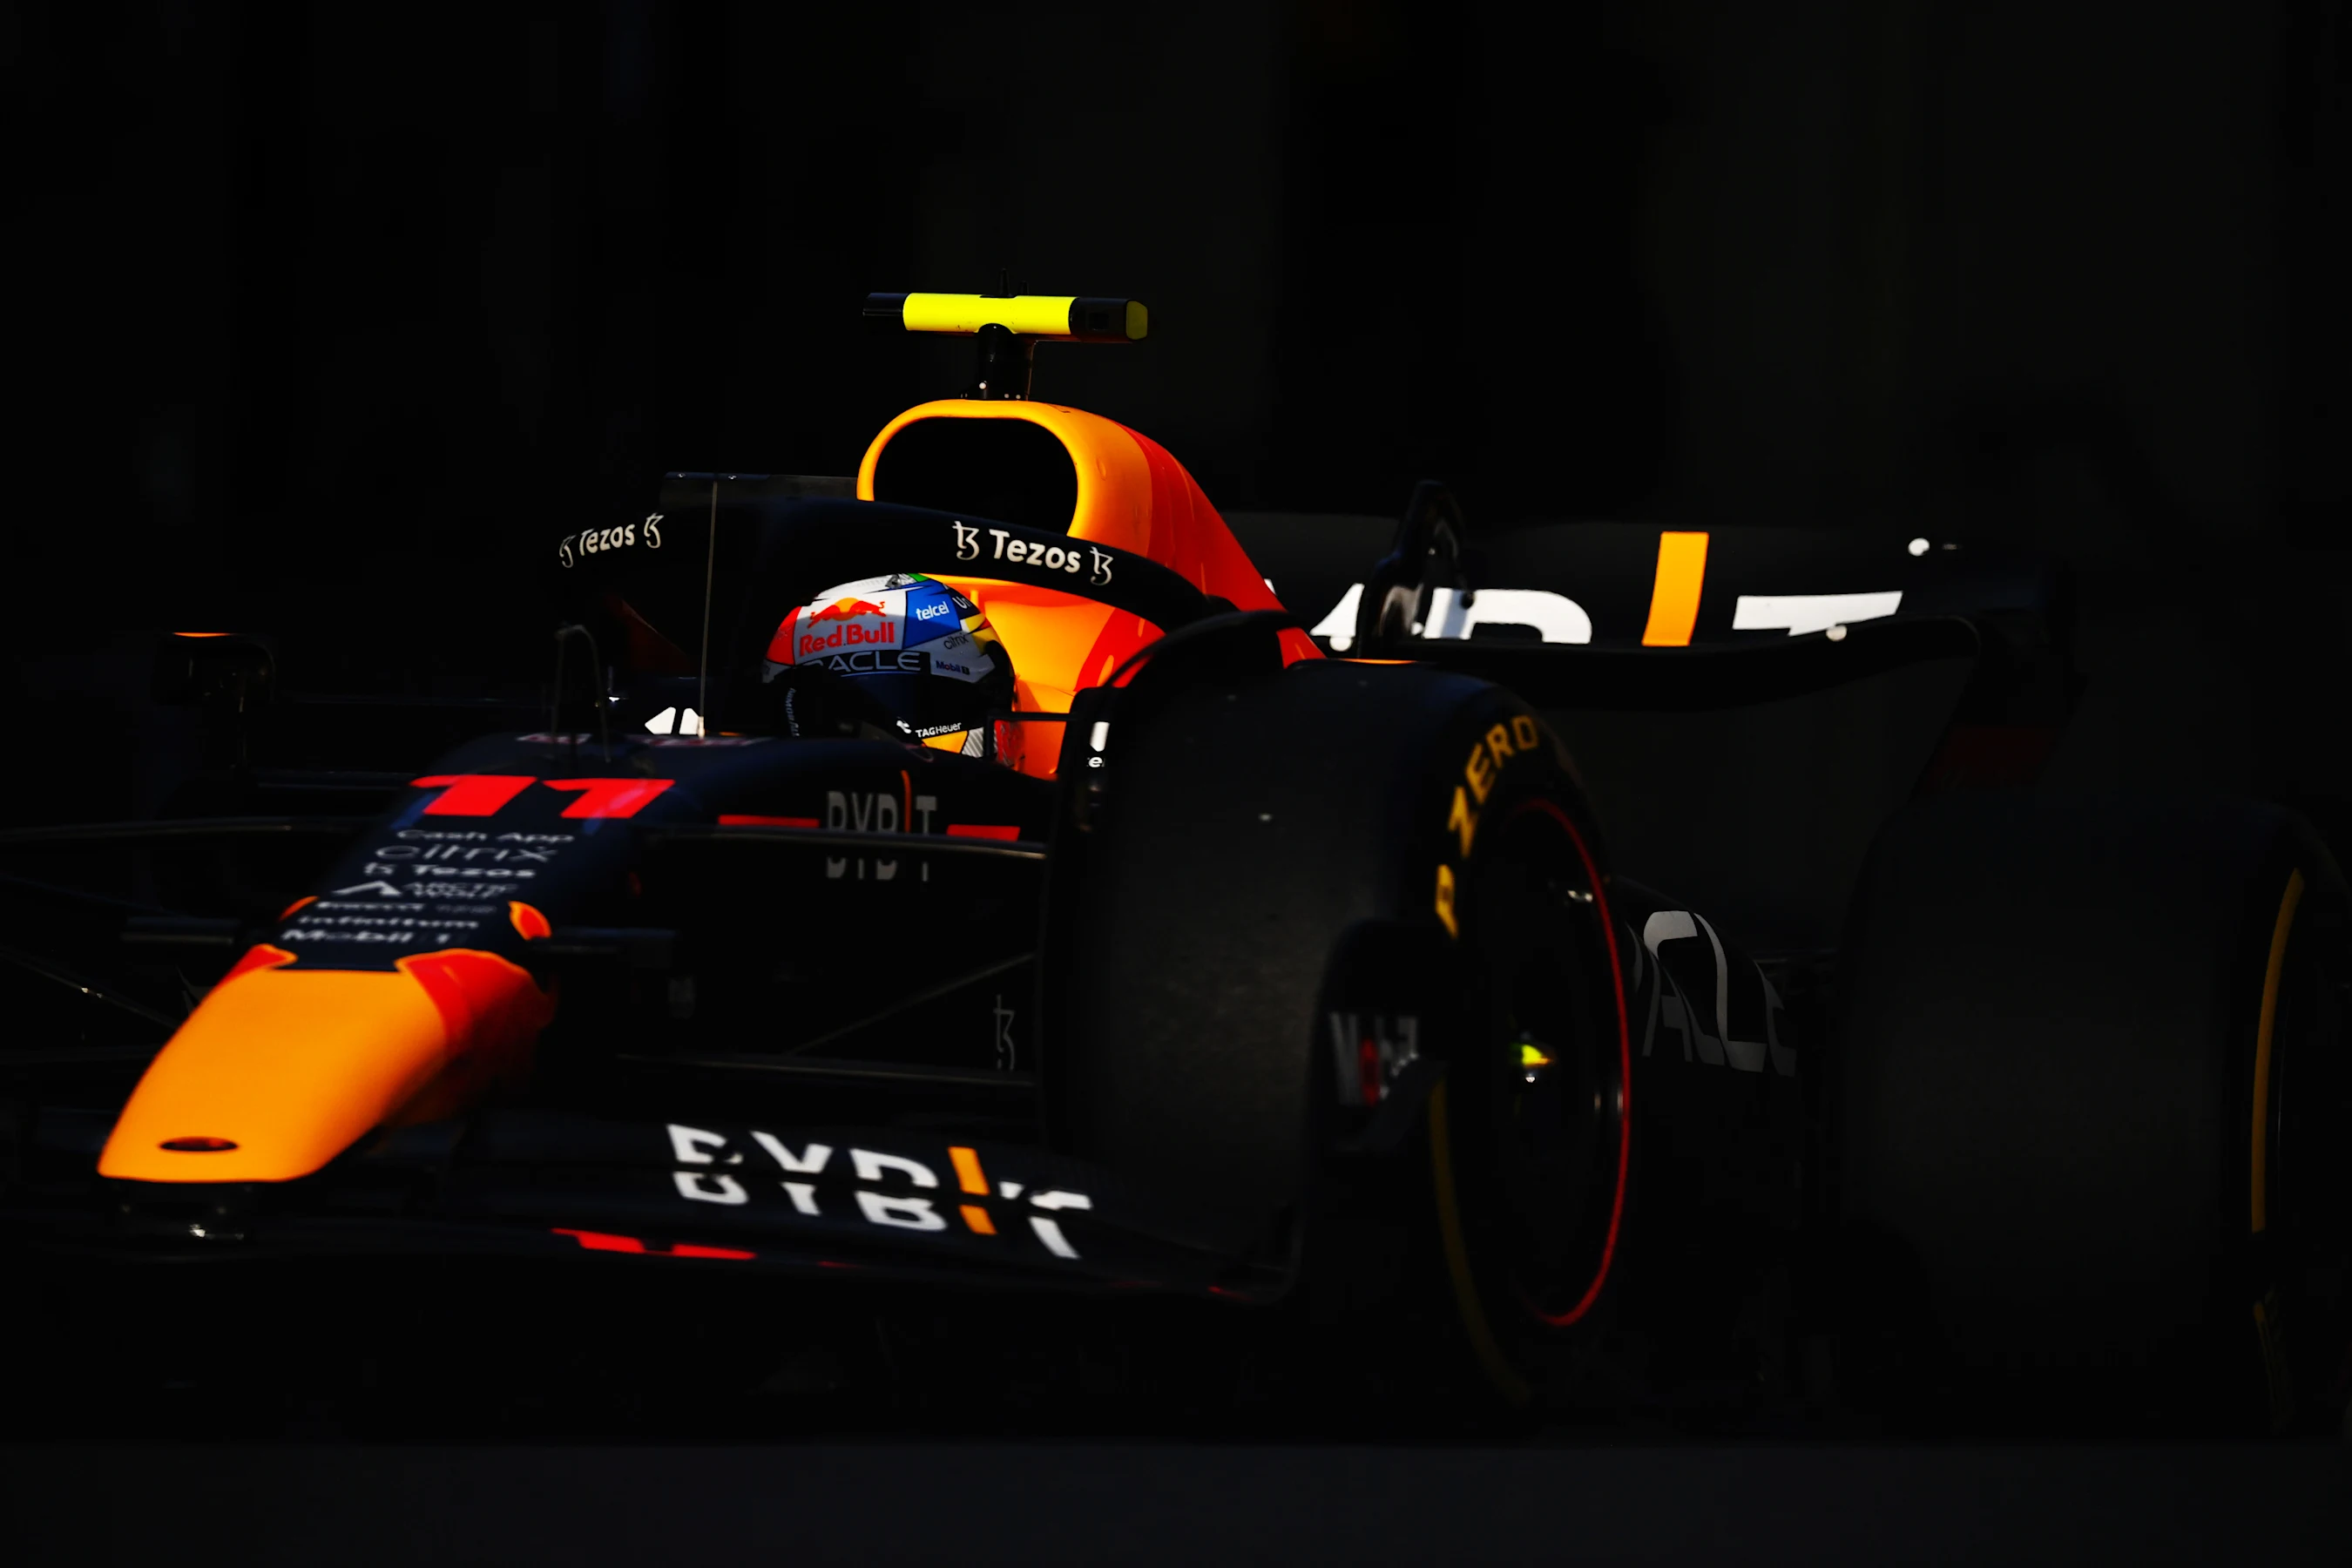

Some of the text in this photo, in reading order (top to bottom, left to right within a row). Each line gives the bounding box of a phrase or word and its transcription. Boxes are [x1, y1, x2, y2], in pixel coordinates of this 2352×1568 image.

[579, 524, 635, 557] Tezos
[989, 528, 1081, 574] Tezos
[916, 600, 950, 621] telcel
[800, 622, 894, 656] Red Bull
[943, 634, 969, 650] citrix
[936, 660, 961, 673] Mobil
[409, 774, 674, 820] 11
[1445, 713, 1541, 861] ZERO
[396, 829, 576, 845] Cash App
[411, 862, 537, 879] Tezos
[280, 927, 414, 944] Mobil
[666, 1123, 1094, 1260] BYBIT
